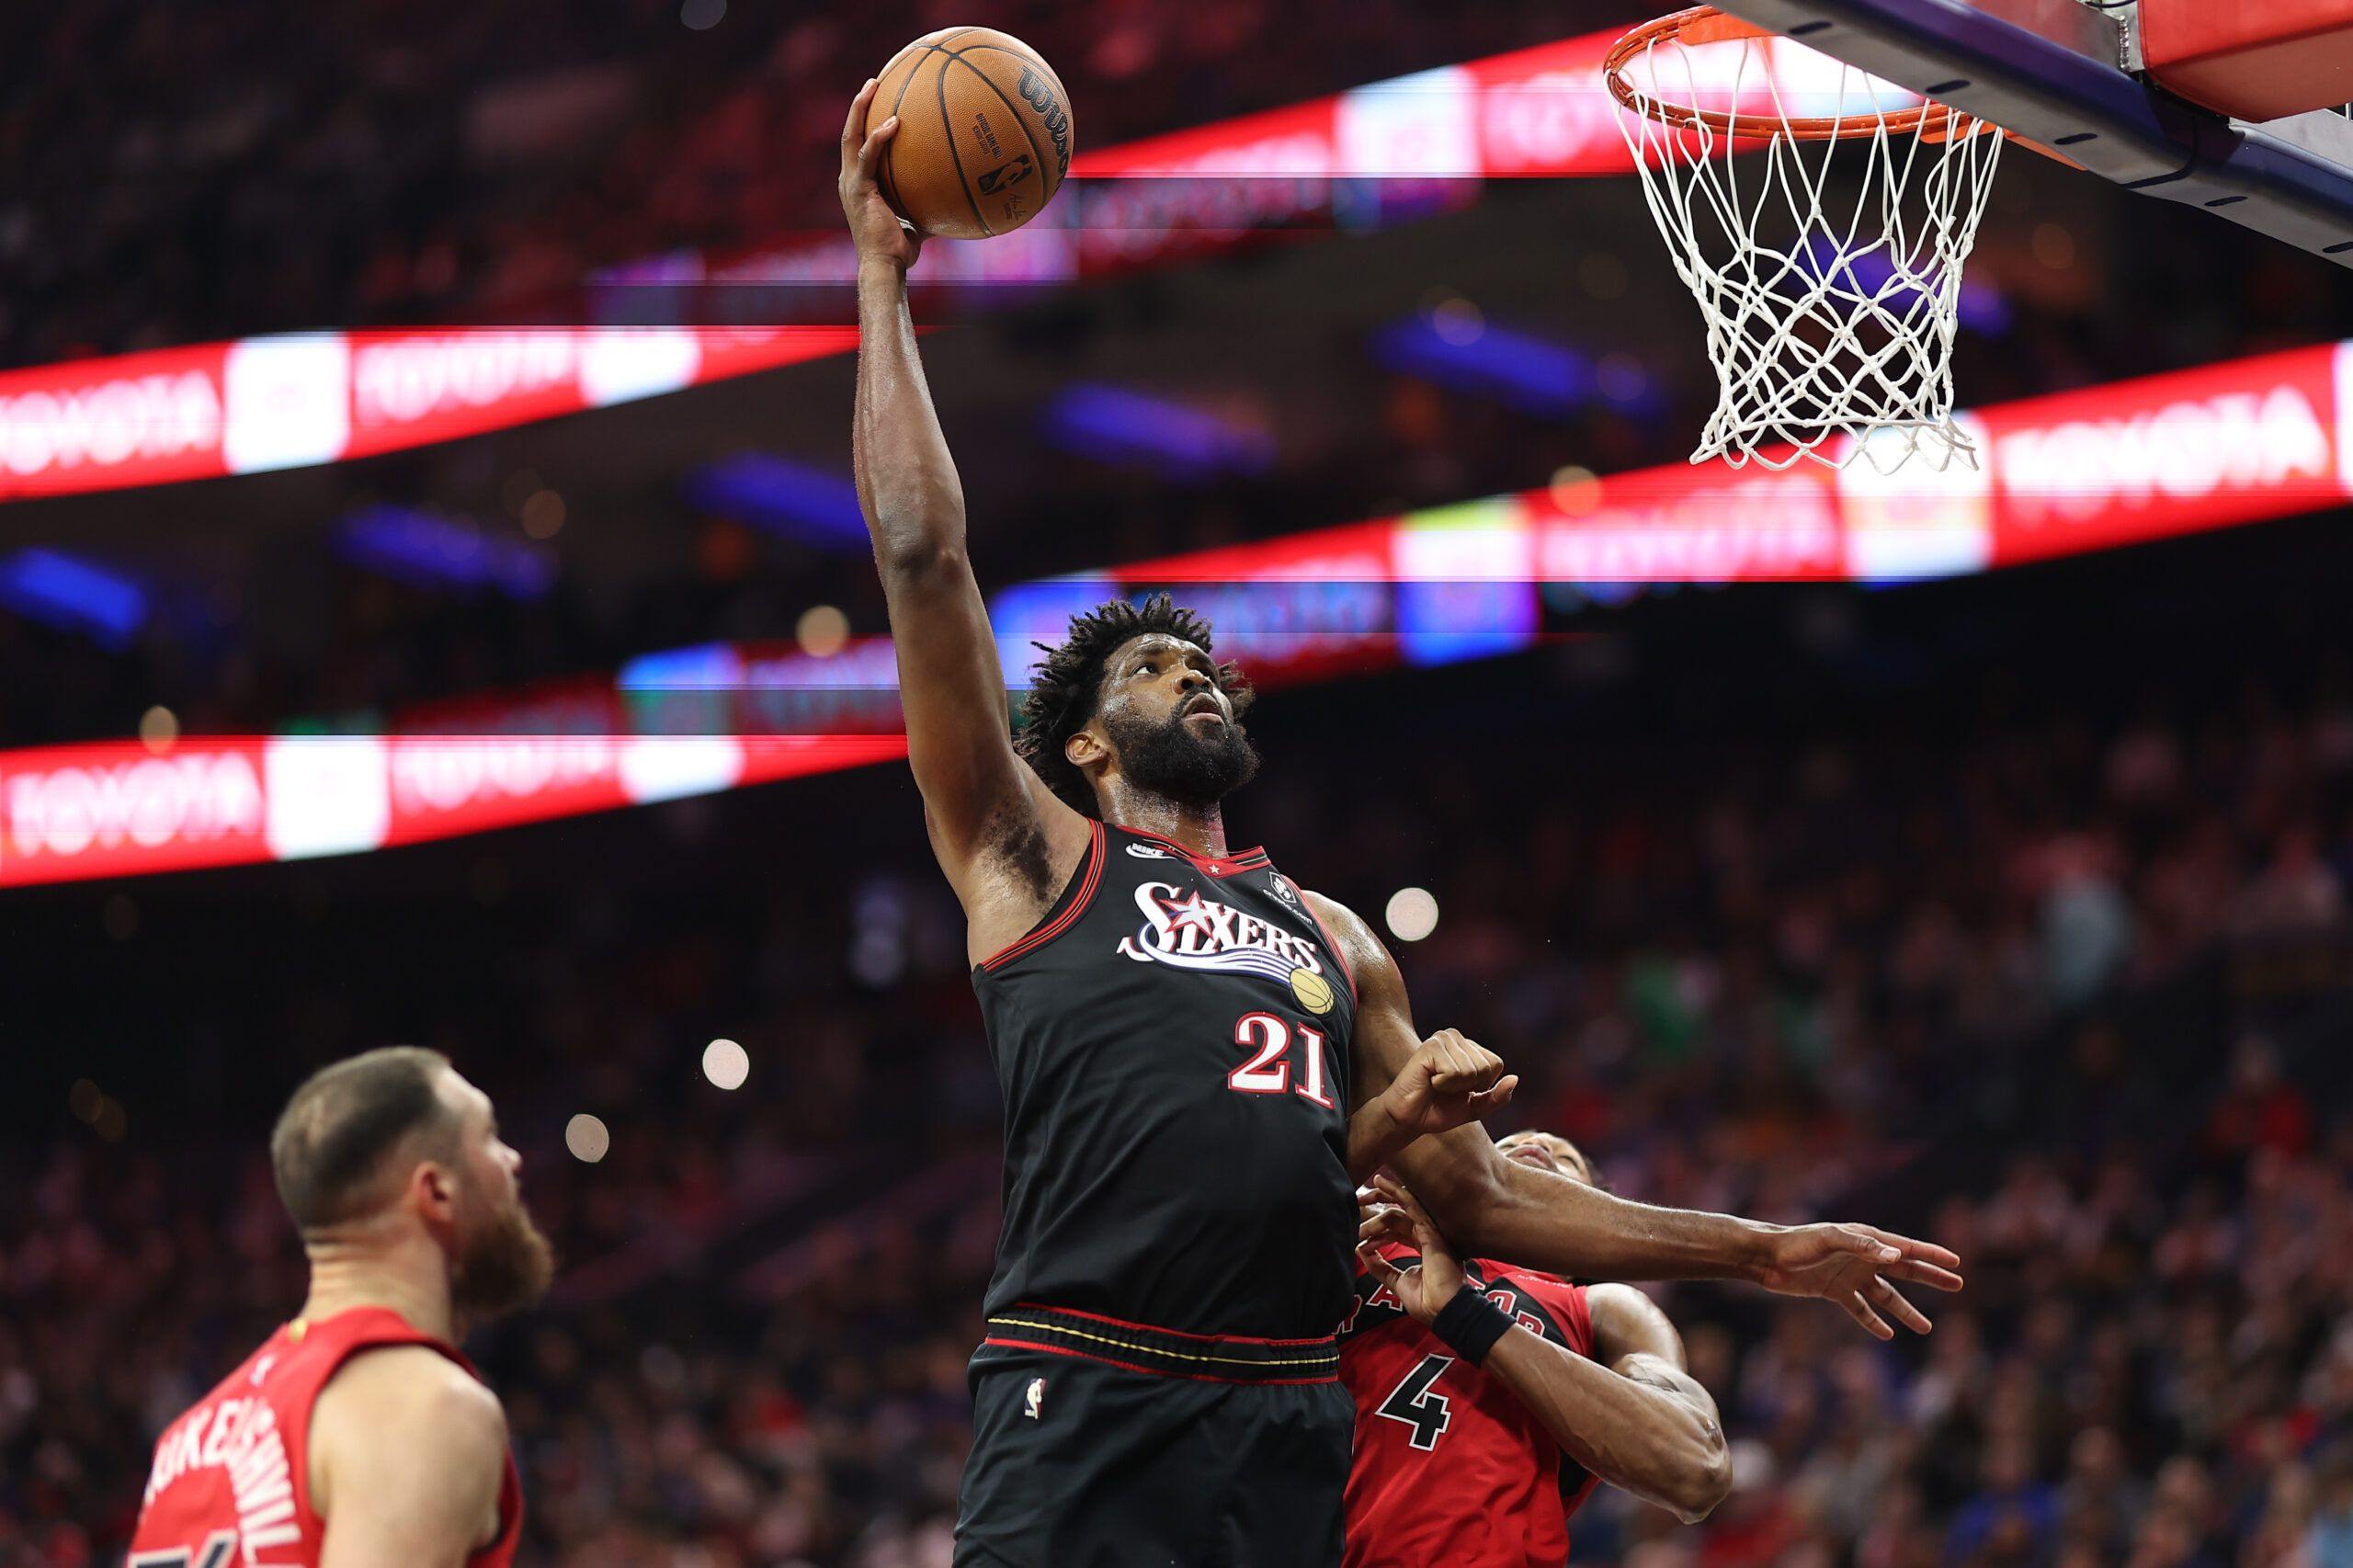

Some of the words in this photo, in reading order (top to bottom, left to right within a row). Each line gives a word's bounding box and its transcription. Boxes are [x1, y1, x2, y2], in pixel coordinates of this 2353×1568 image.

[1017, 65, 1068, 181] Wilso
[0, 369, 222, 475] OYOTA
[1131, 842, 1165, 858] NIKE
[1116, 881, 1324, 975] SIXERS
[1228, 1011, 1335, 1109] 21
[1375, 1353, 1455, 1451] 4
